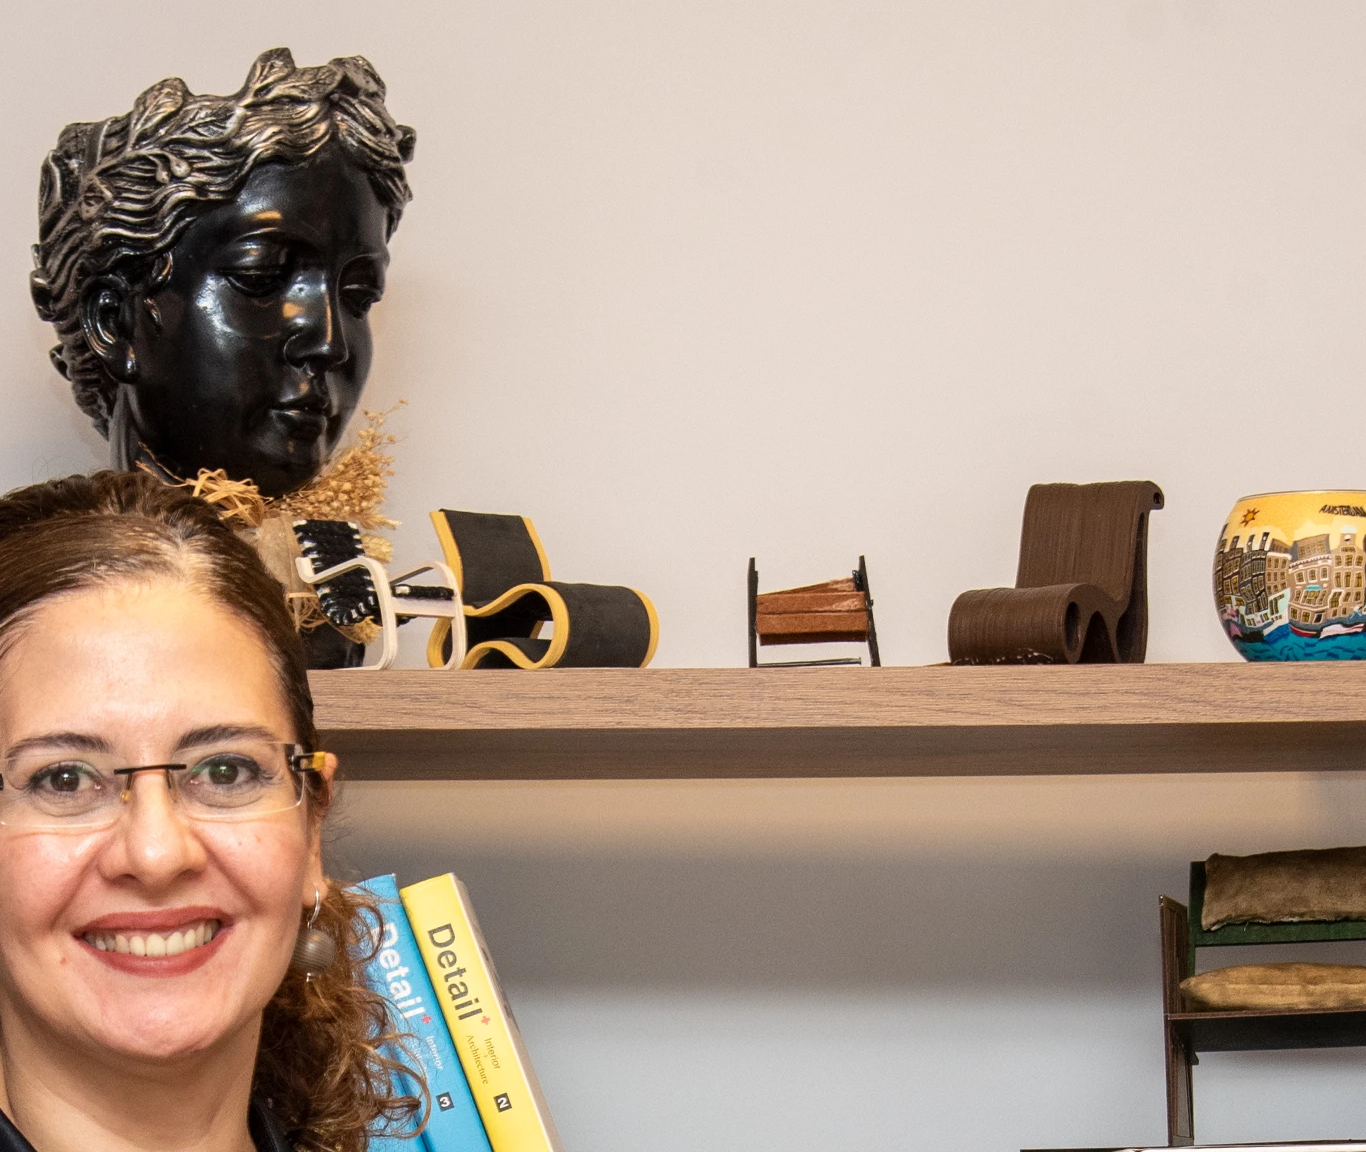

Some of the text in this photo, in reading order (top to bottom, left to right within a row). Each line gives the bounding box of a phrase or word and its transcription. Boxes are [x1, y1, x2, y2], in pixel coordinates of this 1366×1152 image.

[428, 923, 482, 1021] Detail
[466, 1035, 488, 1084] Architecture
[484, 1037, 501, 1069] Interior
[439, 1096, 450, 1107] 3
[497, 1097, 509, 1108] 2
